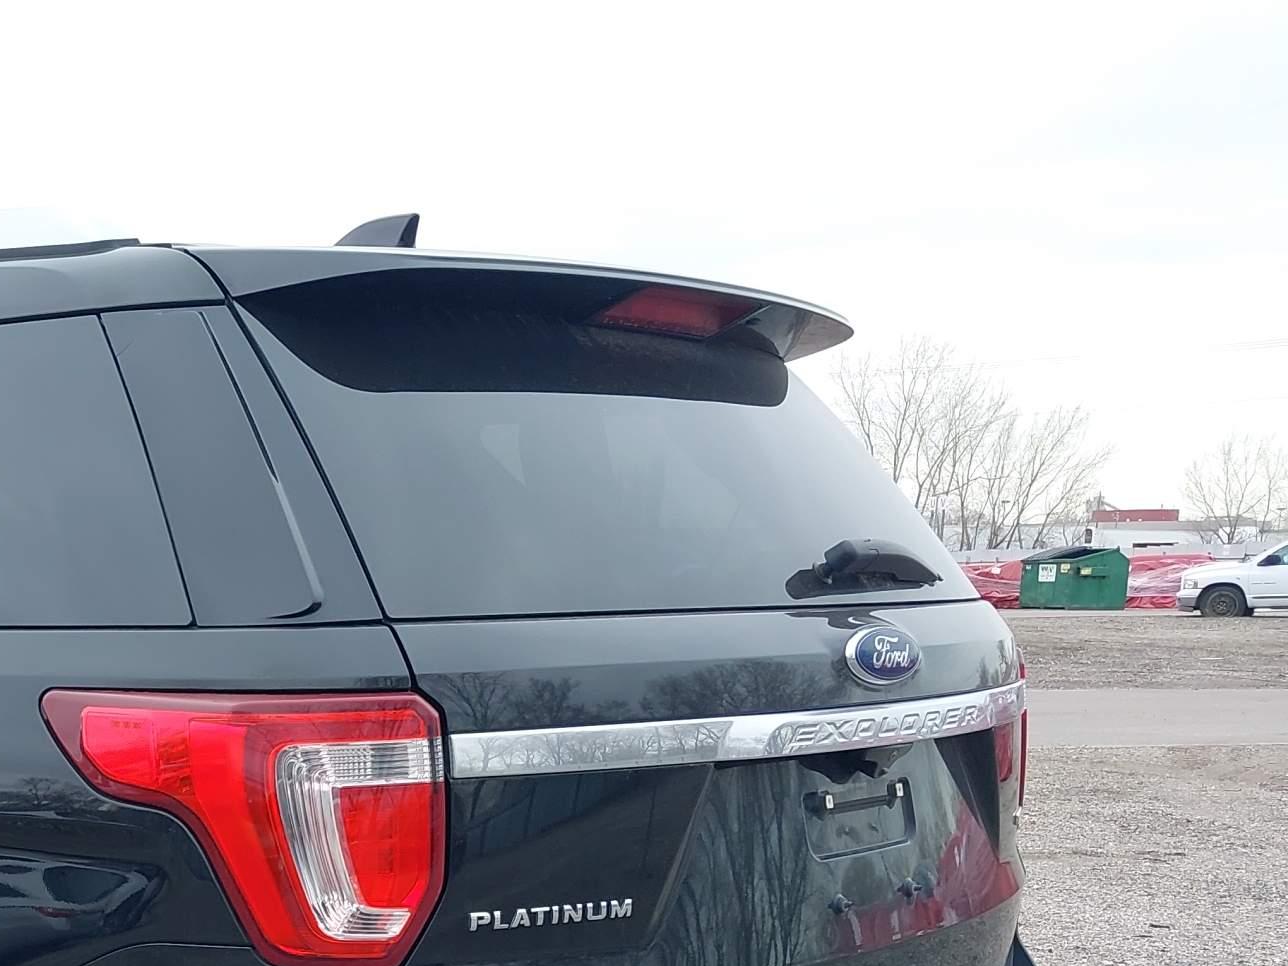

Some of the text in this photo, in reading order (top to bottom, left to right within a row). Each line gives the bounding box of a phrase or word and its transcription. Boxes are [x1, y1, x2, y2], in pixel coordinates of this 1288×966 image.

[873, 635, 911, 669] Ford
[792, 704, 978, 744] EXPLORER
[468, 899, 633, 931] PLATINUM
